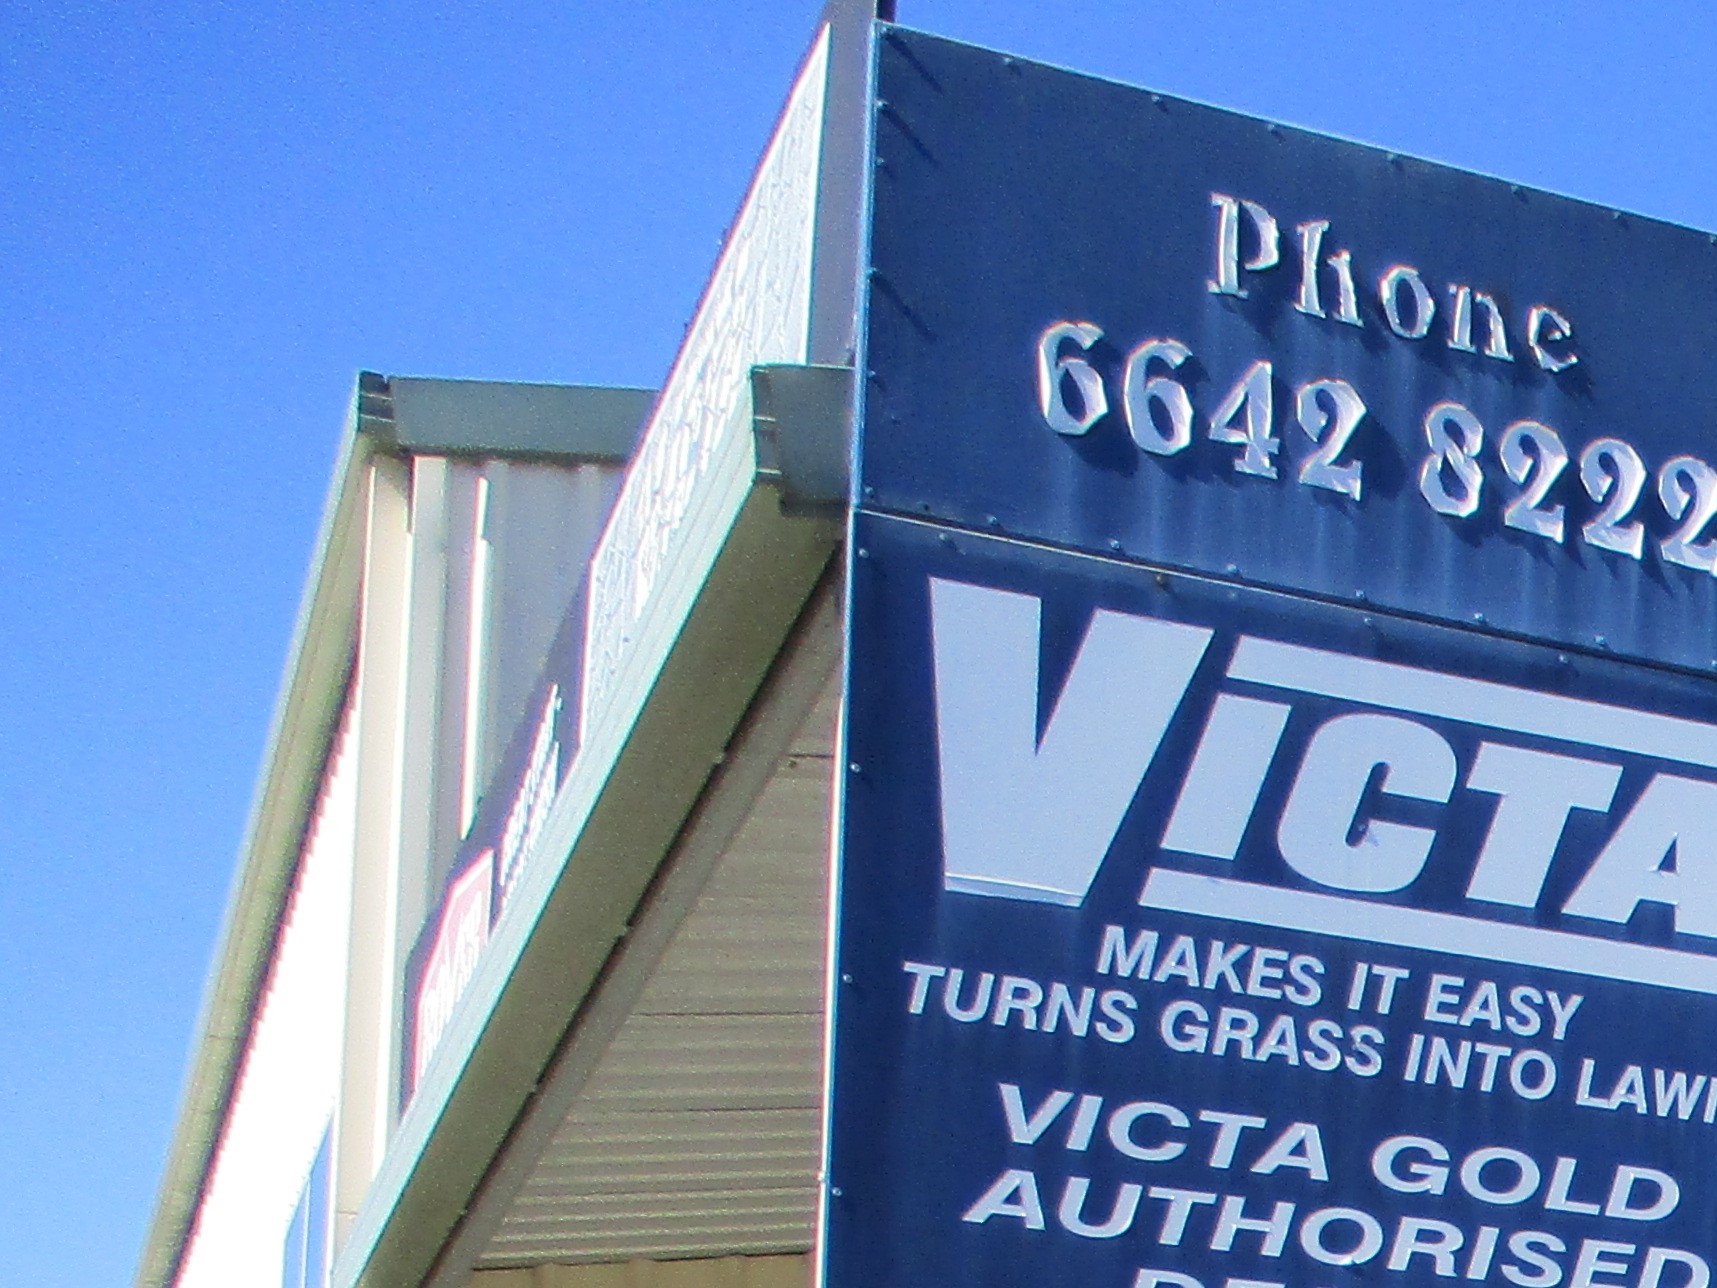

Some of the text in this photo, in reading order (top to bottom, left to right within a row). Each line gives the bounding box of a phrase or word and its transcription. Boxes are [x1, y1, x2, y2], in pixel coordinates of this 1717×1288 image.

[1205, 193, 1578, 372] Phone
[1038, 320, 1367, 503] 6642
[902, 960, 1135, 1044] TURNS
[1159, 999, 1384, 1078] GRASS
[1404, 1033, 1557, 1102] INTO
[1098, 925, 1583, 1042] MAKES IT EASY
[997, 1082, 1681, 1223] VICTA GOLD
